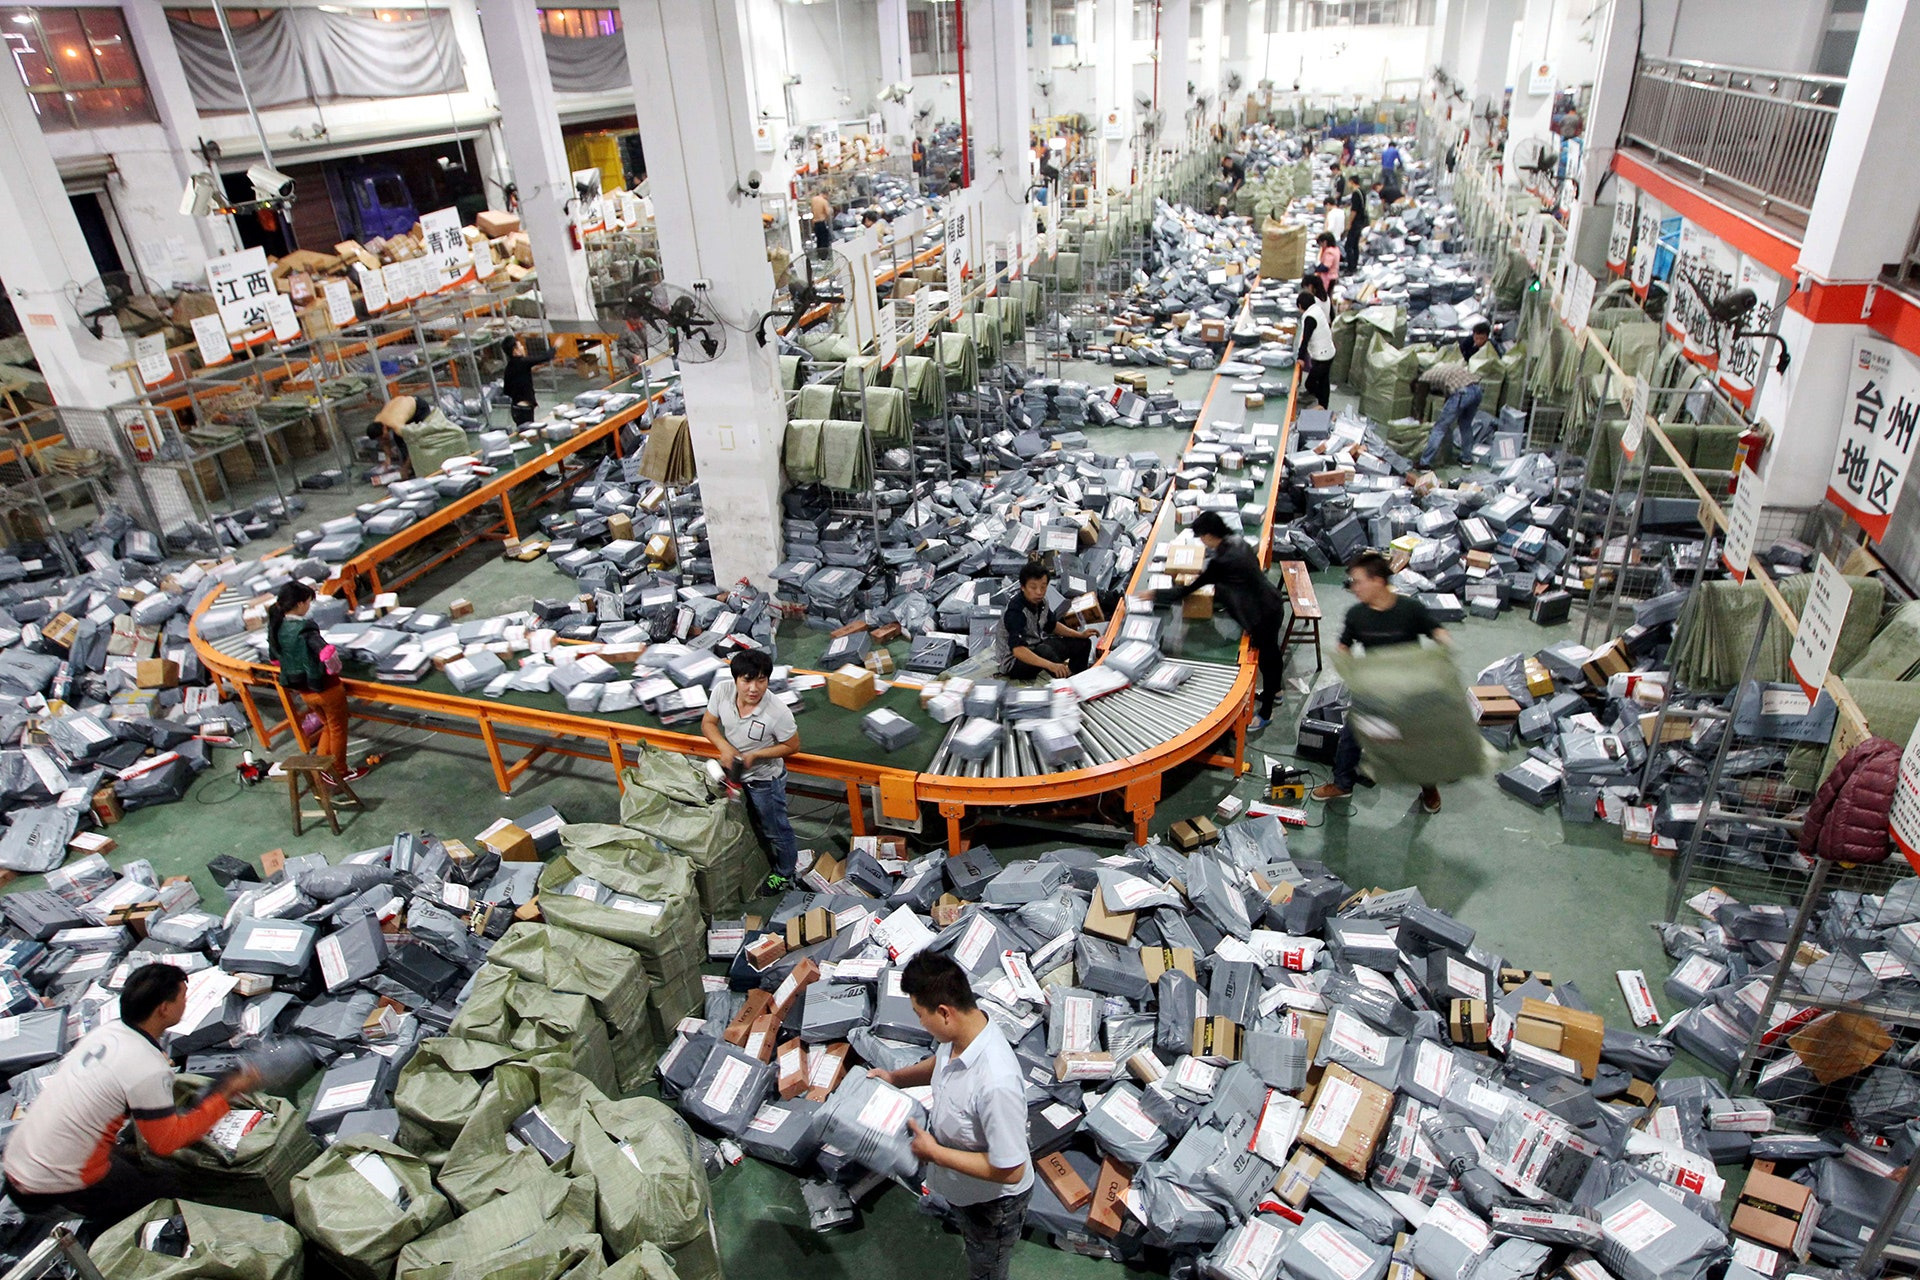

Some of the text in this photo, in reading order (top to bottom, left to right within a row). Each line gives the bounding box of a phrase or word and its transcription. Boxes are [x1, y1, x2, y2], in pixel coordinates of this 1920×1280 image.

[427, 226, 463, 254] 青海
[444, 256, 462, 279] 省
[216, 269, 271, 306] 江西
[1727, 335, 1760, 388] 地区
[1856, 380, 1920, 454] 台州
[1838, 438, 1899, 515] 地区
[1233, 1154, 1246, 1172] STO
